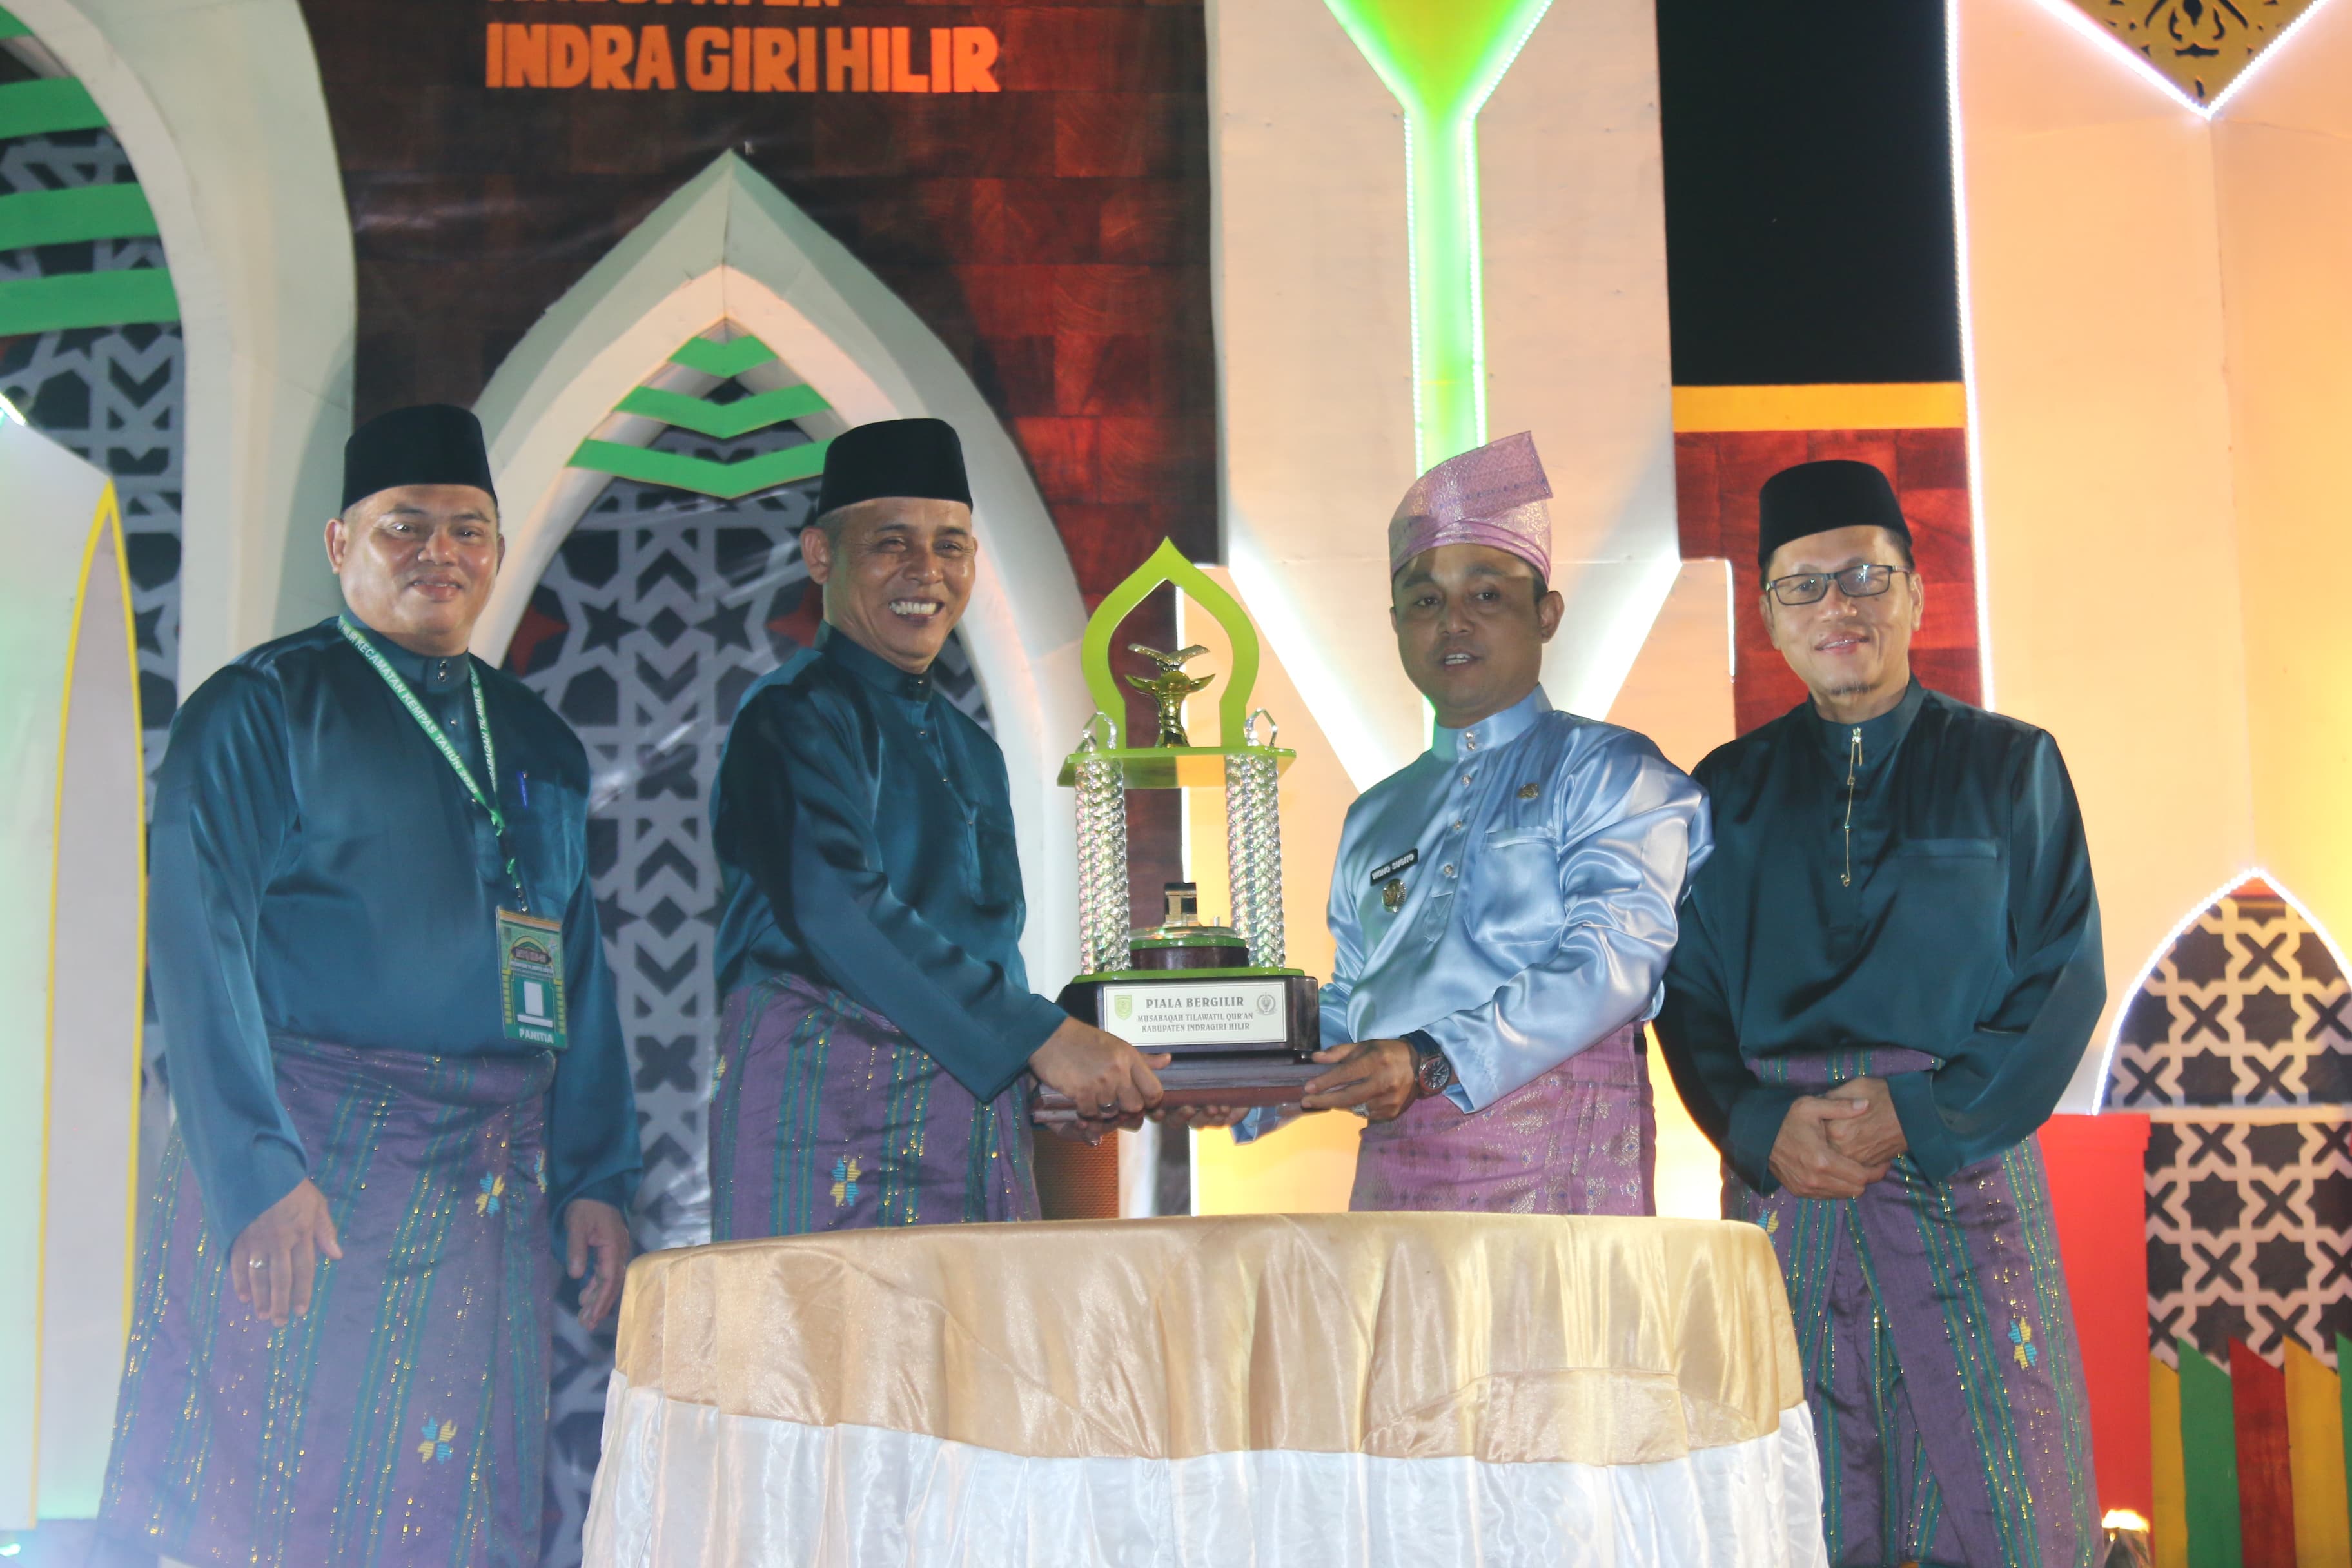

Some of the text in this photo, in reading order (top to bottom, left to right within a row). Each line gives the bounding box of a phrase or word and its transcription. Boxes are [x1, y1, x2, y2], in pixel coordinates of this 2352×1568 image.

[485, 23, 1001, 93] INDRA GIRI HILIR
[355, 639, 406, 693] KECAMATAN
[402, 692, 438, 734] KEMPAS
[435, 733, 462, 769] TAHUN
[1146, 997, 1244, 1009] PIALA BERGILIR
[1137, 1012, 1253, 1023] MUSABAQAH TILAWATIL QUR'AN
[1187, 1023, 1226, 1032] INDRAGIRI
[519, 1028, 554, 1044] PANITIA
